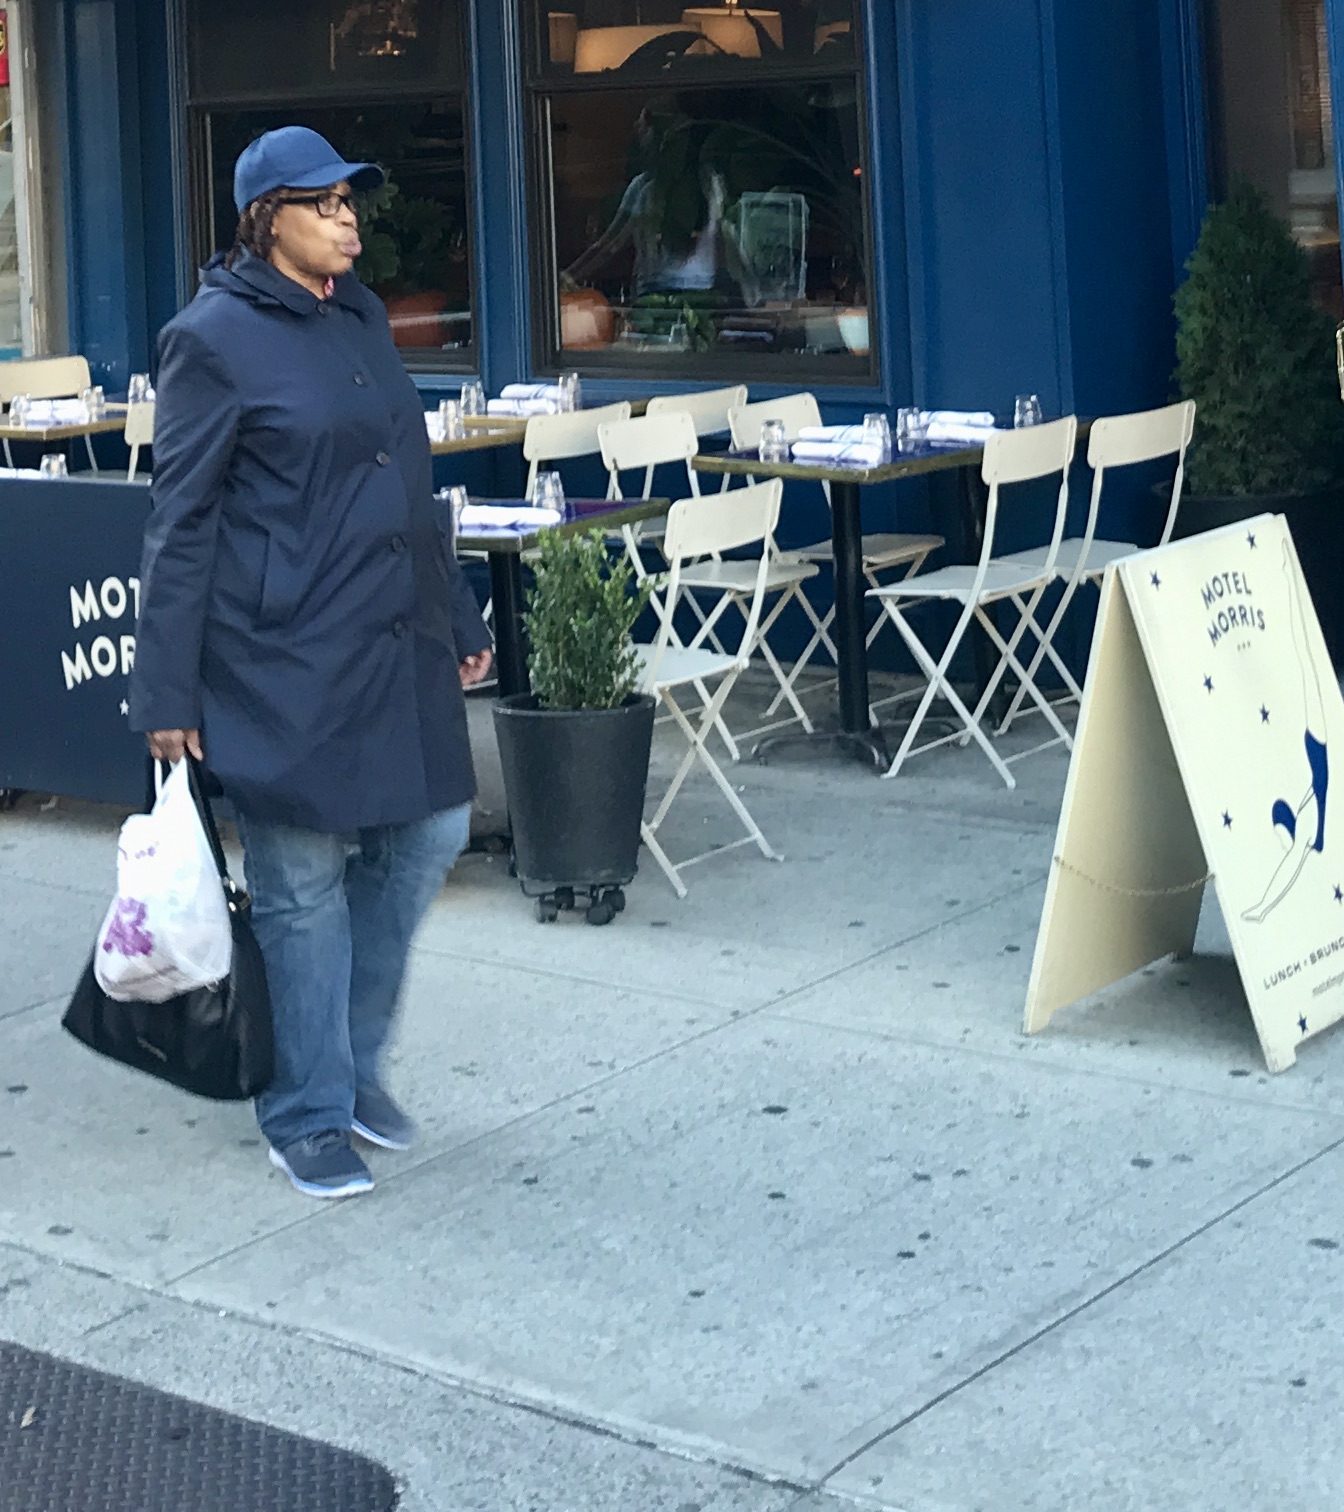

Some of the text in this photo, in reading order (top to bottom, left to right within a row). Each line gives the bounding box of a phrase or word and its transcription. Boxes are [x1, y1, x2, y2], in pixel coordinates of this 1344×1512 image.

[70, 576, 141, 629] MOT
[1200, 571, 1252, 610] MOTEL
[1207, 604, 1265, 648] MORRIS
[61, 635, 136, 691] MOR
[1263, 961, 1302, 990] LUNCH
